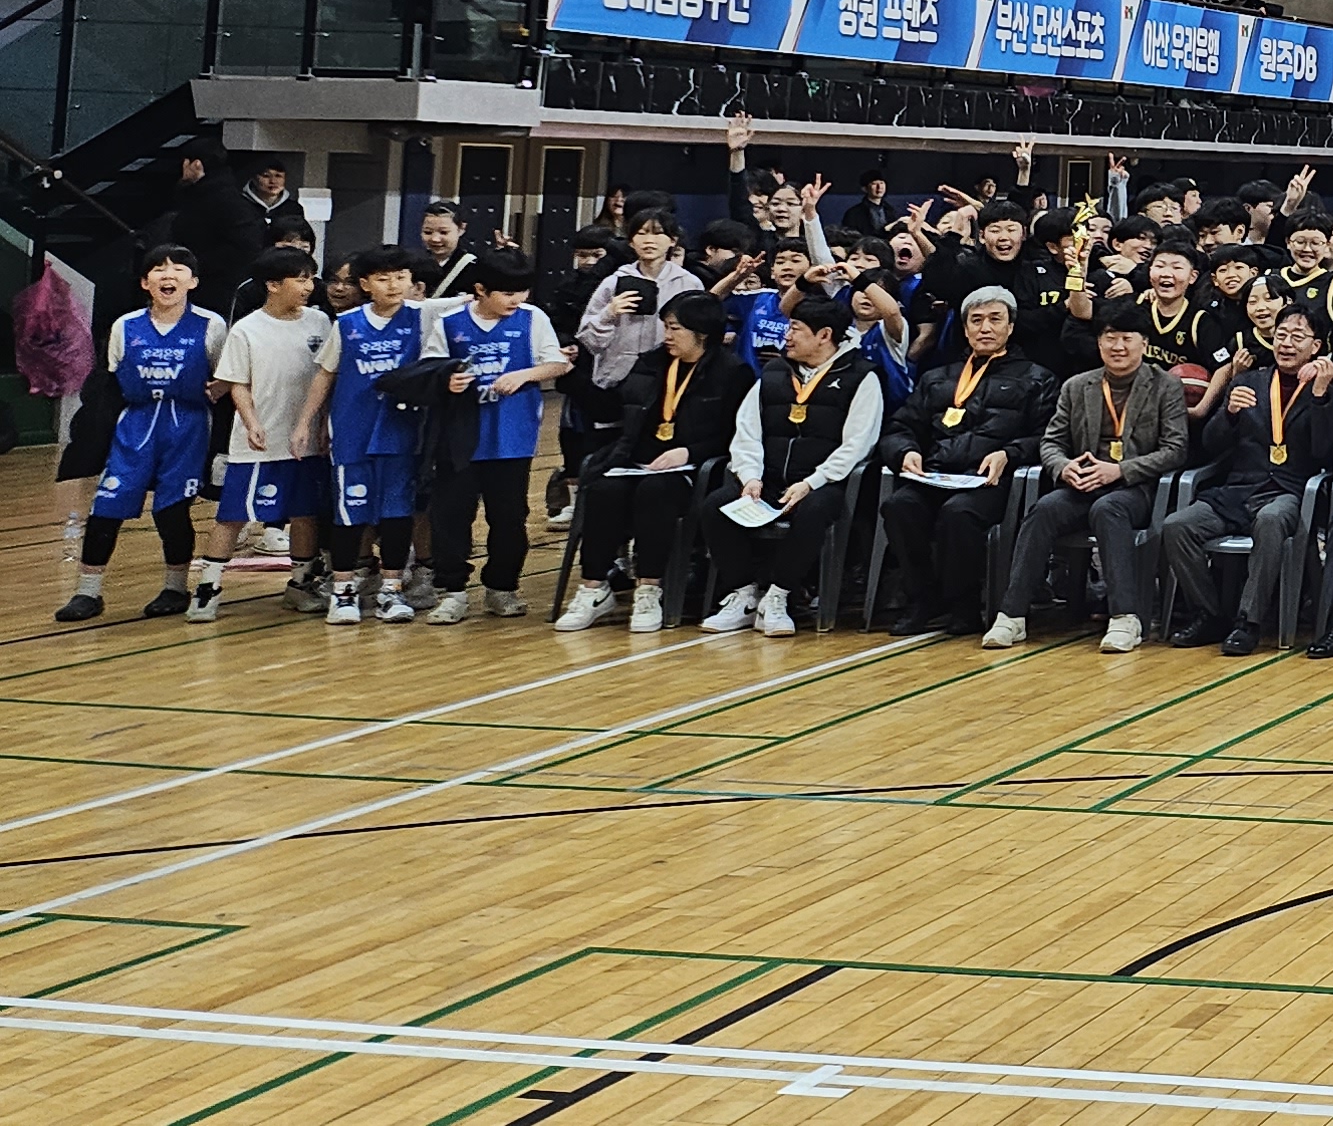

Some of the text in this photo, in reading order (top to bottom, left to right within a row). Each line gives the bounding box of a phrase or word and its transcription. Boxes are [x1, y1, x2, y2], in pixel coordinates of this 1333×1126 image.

[994, 0, 1106, 61] 부산 모션스포츠
[1142, 19, 1221, 75] 아산 우리은행
[1259, 38, 1319, 83] 원주DB
[1039, 290, 1060, 306] 17
[1145, 344, 1188, 365] IENDS
